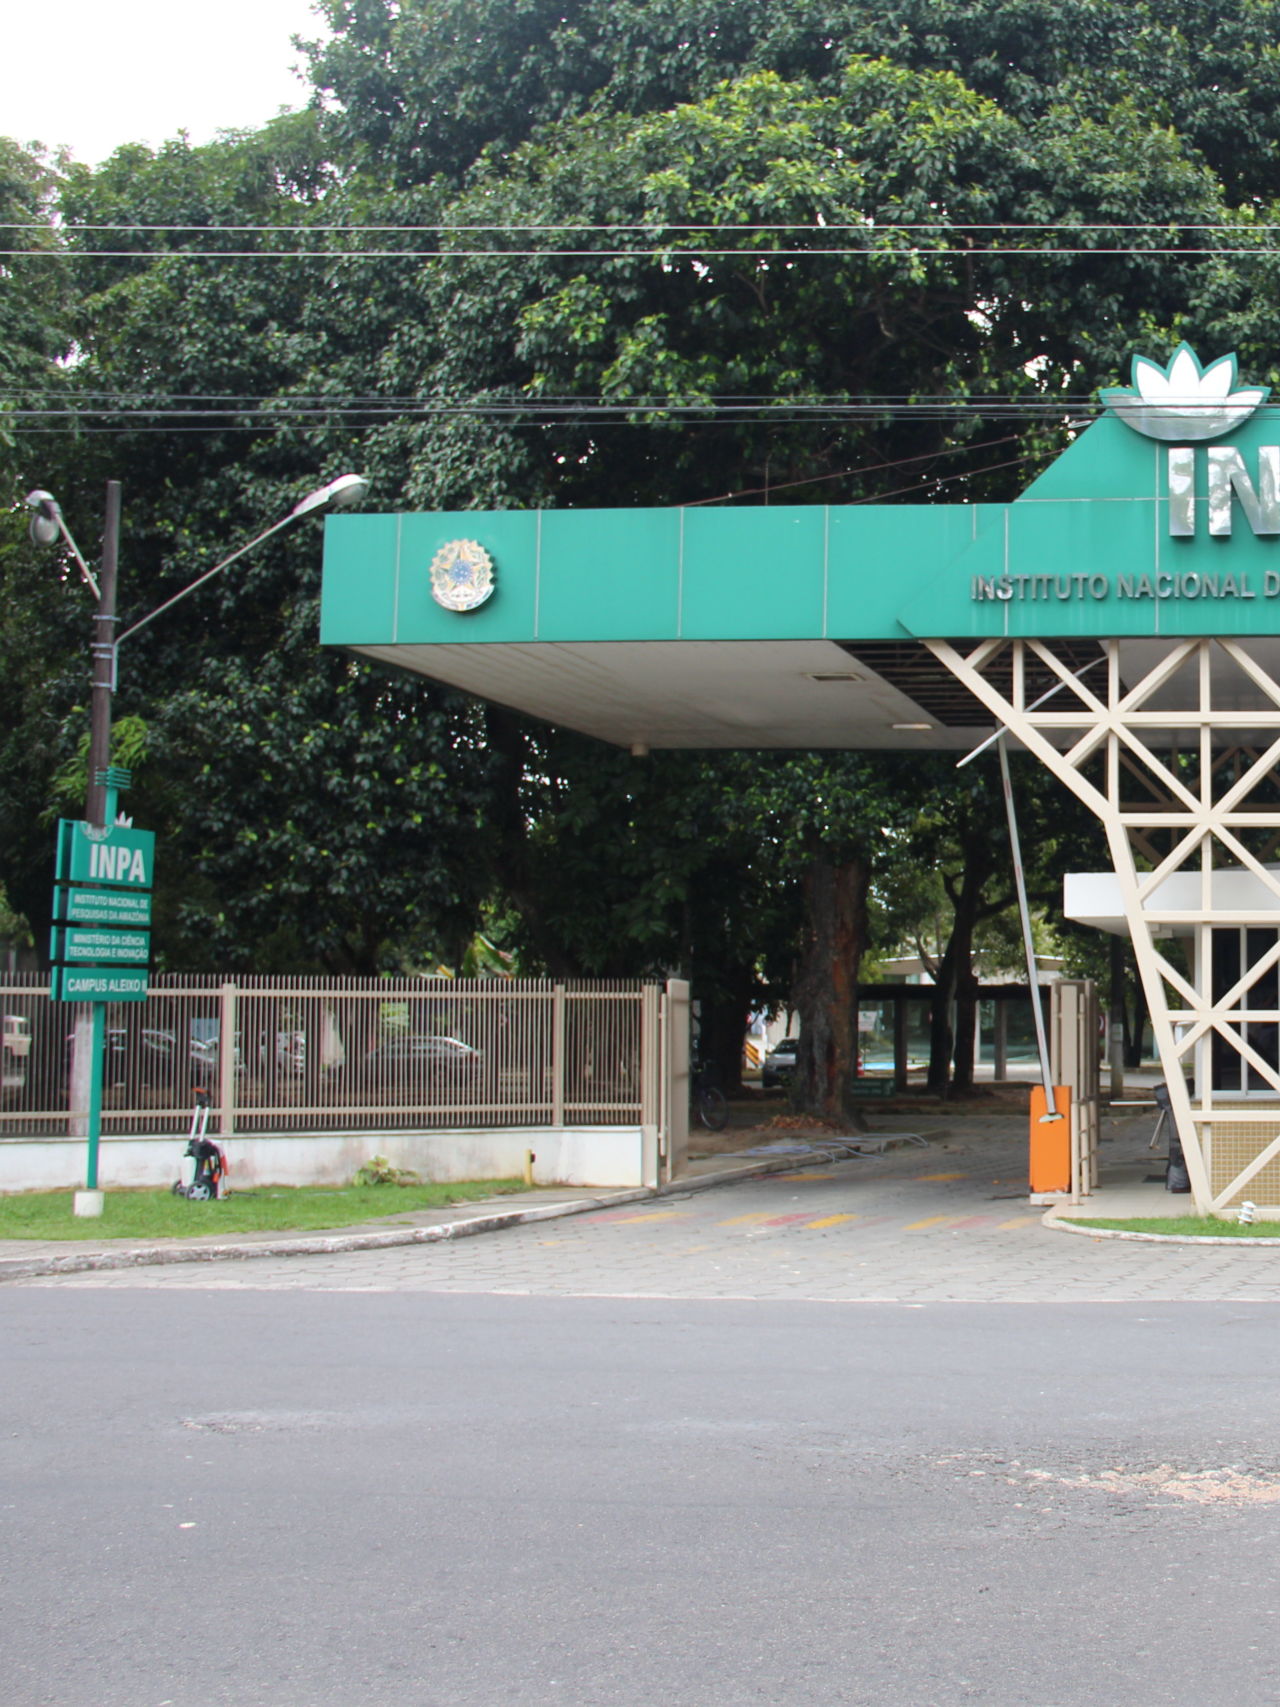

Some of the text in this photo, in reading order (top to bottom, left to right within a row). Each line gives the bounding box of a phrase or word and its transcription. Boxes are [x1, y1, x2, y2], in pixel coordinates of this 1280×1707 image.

[970, 573, 1108, 600] INSTITUTO
[1116, 572, 1256, 599] NACIONAL
[89, 843, 146, 883] INPA
[74, 894, 148, 909] INSTITUTO NACIONAL DE
[72, 908, 107, 919] PESQUISAS
[108, 910, 118, 920] DA
[73, 932, 145, 946] MINISTÉRIO DA CIÊNCIA
[70, 946, 110, 957] TECNOLOGIA
[117, 948, 149, 960] INOVAÇÃO
[68, 979, 107, 992] CAMPUS
[108, 979, 141, 992] ALEIXO
